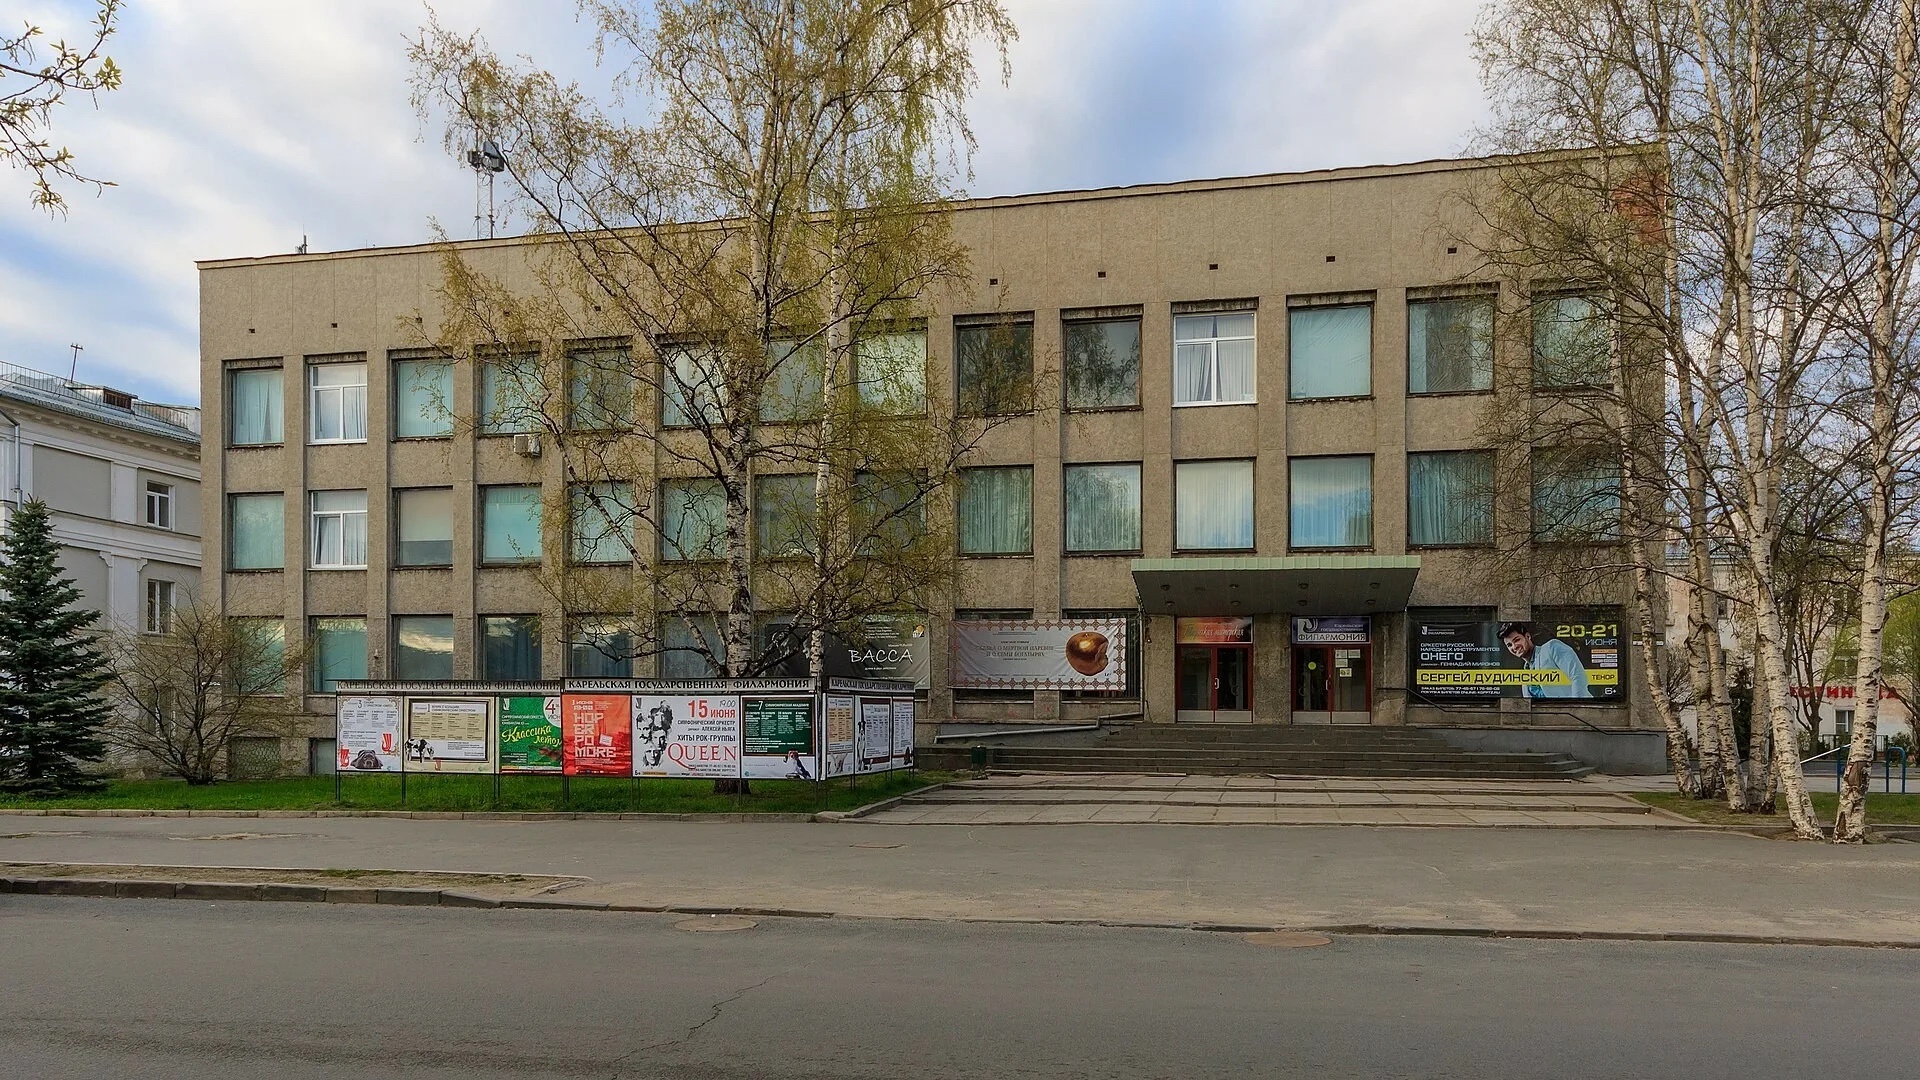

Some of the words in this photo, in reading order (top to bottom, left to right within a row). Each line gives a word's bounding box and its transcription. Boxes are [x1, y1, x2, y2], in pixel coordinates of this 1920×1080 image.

[1557, 624, 1617, 638] 20-21
[1586, 638, 1618, 646] ИЮНЯ
[848, 649, 913, 664] ВАССА
[1421, 652, 1464, 660] ОНЕГО
[1421, 671, 1471, 682] СЕРГЕЙ
[1475, 672, 1560, 684] ДУДИНСКИЙ
[338, 681, 397, 689] КАРЕЛЬСКАЯ
[400, 681, 491, 690] ГОСУДАРСТВЕННАЯ
[495, 681, 560, 690] ФИЛАРМОНИЯ
[569, 680, 631, 689] КАРЕЛЬСКАЯ
[635, 680, 727, 689] ГОСУДАРСТВЕННАЯ
[733, 680, 809, 689] ФИЛАРМОНИЯ
[545, 699, 556, 714] 4
[688, 700, 708, 718] 15
[711, 710, 736, 718] ИЮНЯ
[758, 701, 763, 710] 7
[502, 726, 551, 743] Классика
[668, 743, 737, 770] QUEEN
